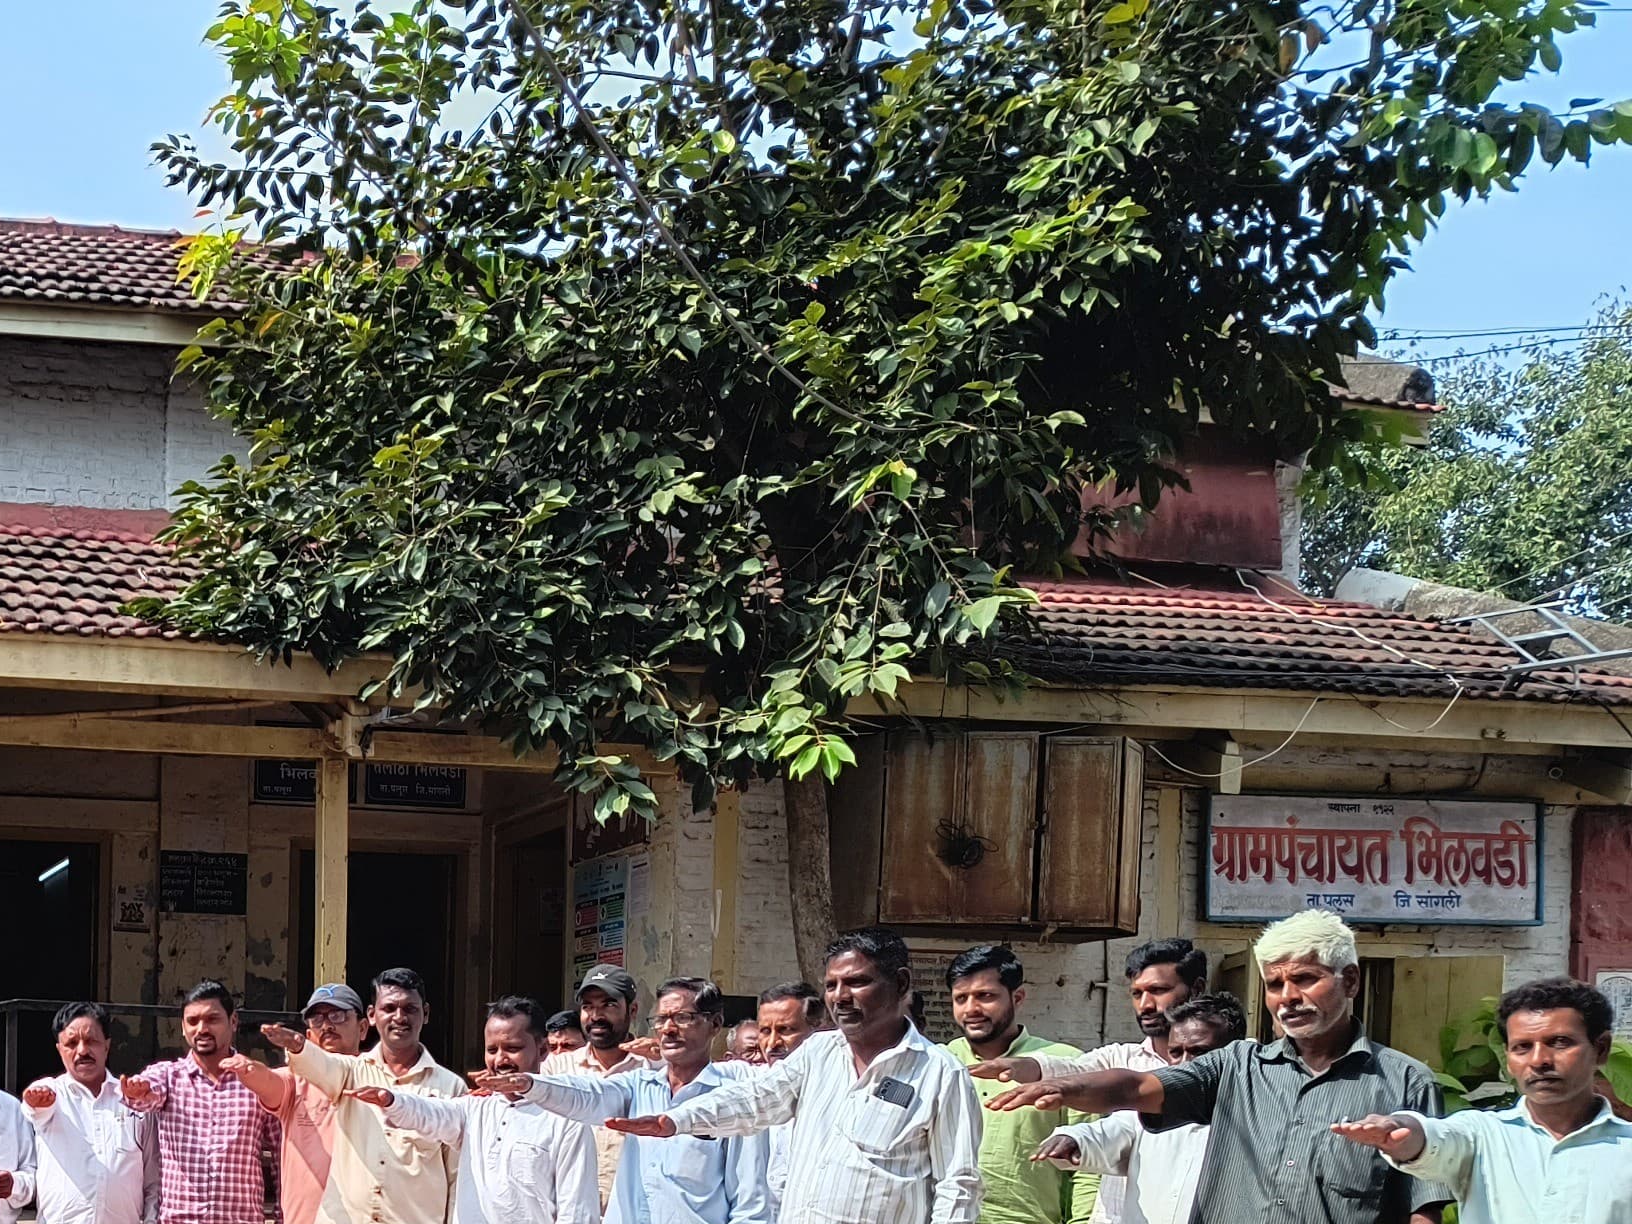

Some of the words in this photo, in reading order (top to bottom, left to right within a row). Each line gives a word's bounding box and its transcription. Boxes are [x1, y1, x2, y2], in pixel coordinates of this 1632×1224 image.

[280, 762, 321, 780] भिलव
[1211, 815, 1394, 885] ग्रामपंचायत
[1399, 816, 1534, 889] भिलवडी
[1416, 890, 1462, 909] सांगली
